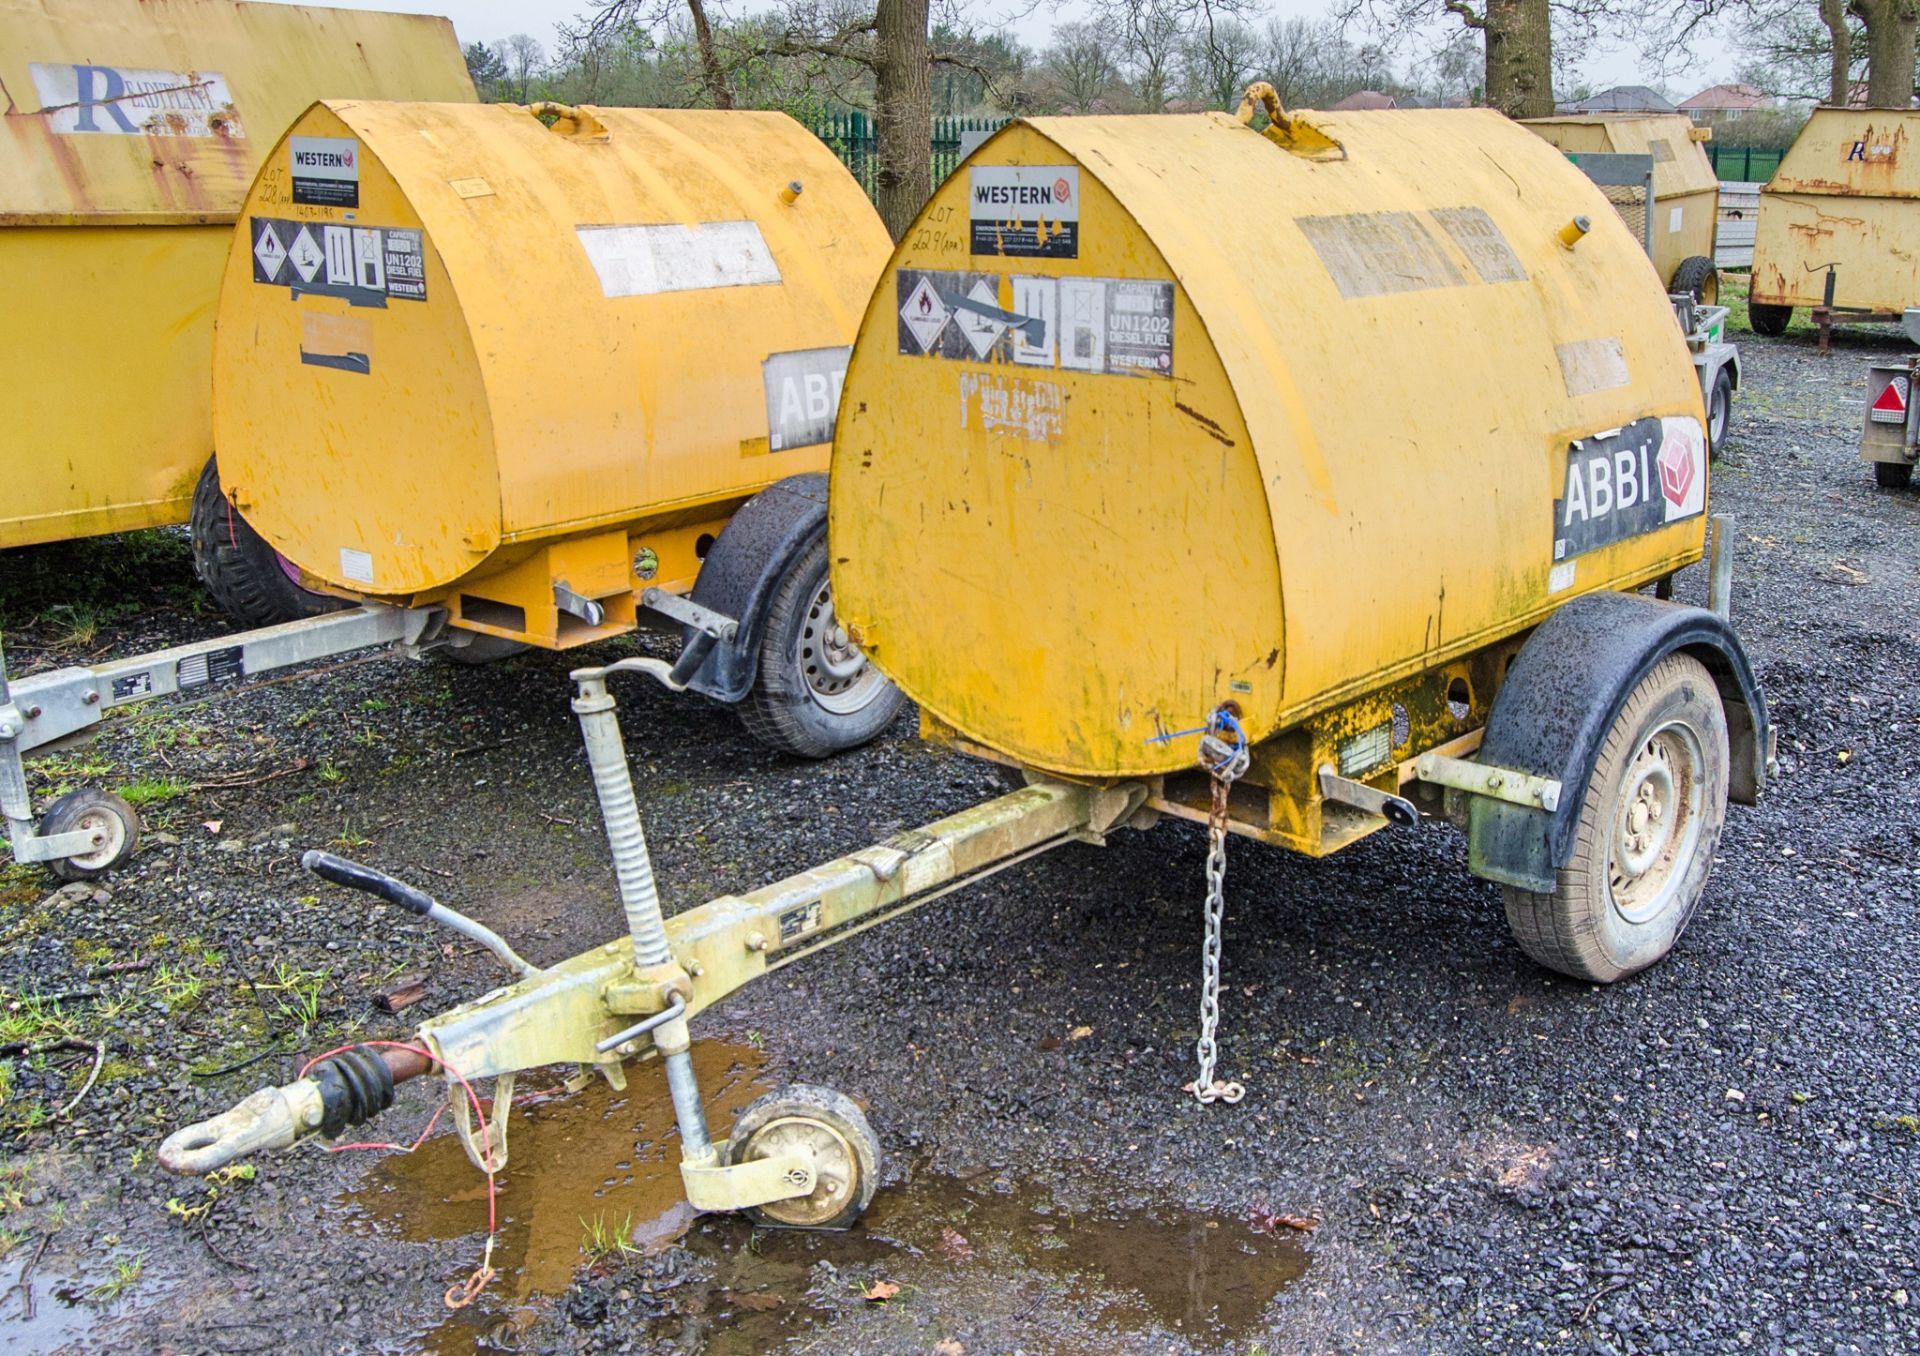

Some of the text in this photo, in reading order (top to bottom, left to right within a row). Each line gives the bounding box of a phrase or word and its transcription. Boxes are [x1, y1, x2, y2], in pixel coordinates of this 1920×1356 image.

[295, 152, 342, 167] WESTERN
[975, 186, 1051, 204] WESTERN
[928, 201, 954, 224] LOT
[385, 253, 422, 268] UN1202
[386, 265, 423, 278] DIESEL FUEL
[388, 282, 418, 293] WESTERN
[1109, 314, 1170, 333] UN1202
[1109, 330, 1170, 346] DIESEL FUEL
[1109, 353, 1160, 369] WESTERN
[1564, 444, 1650, 527] ABBI
